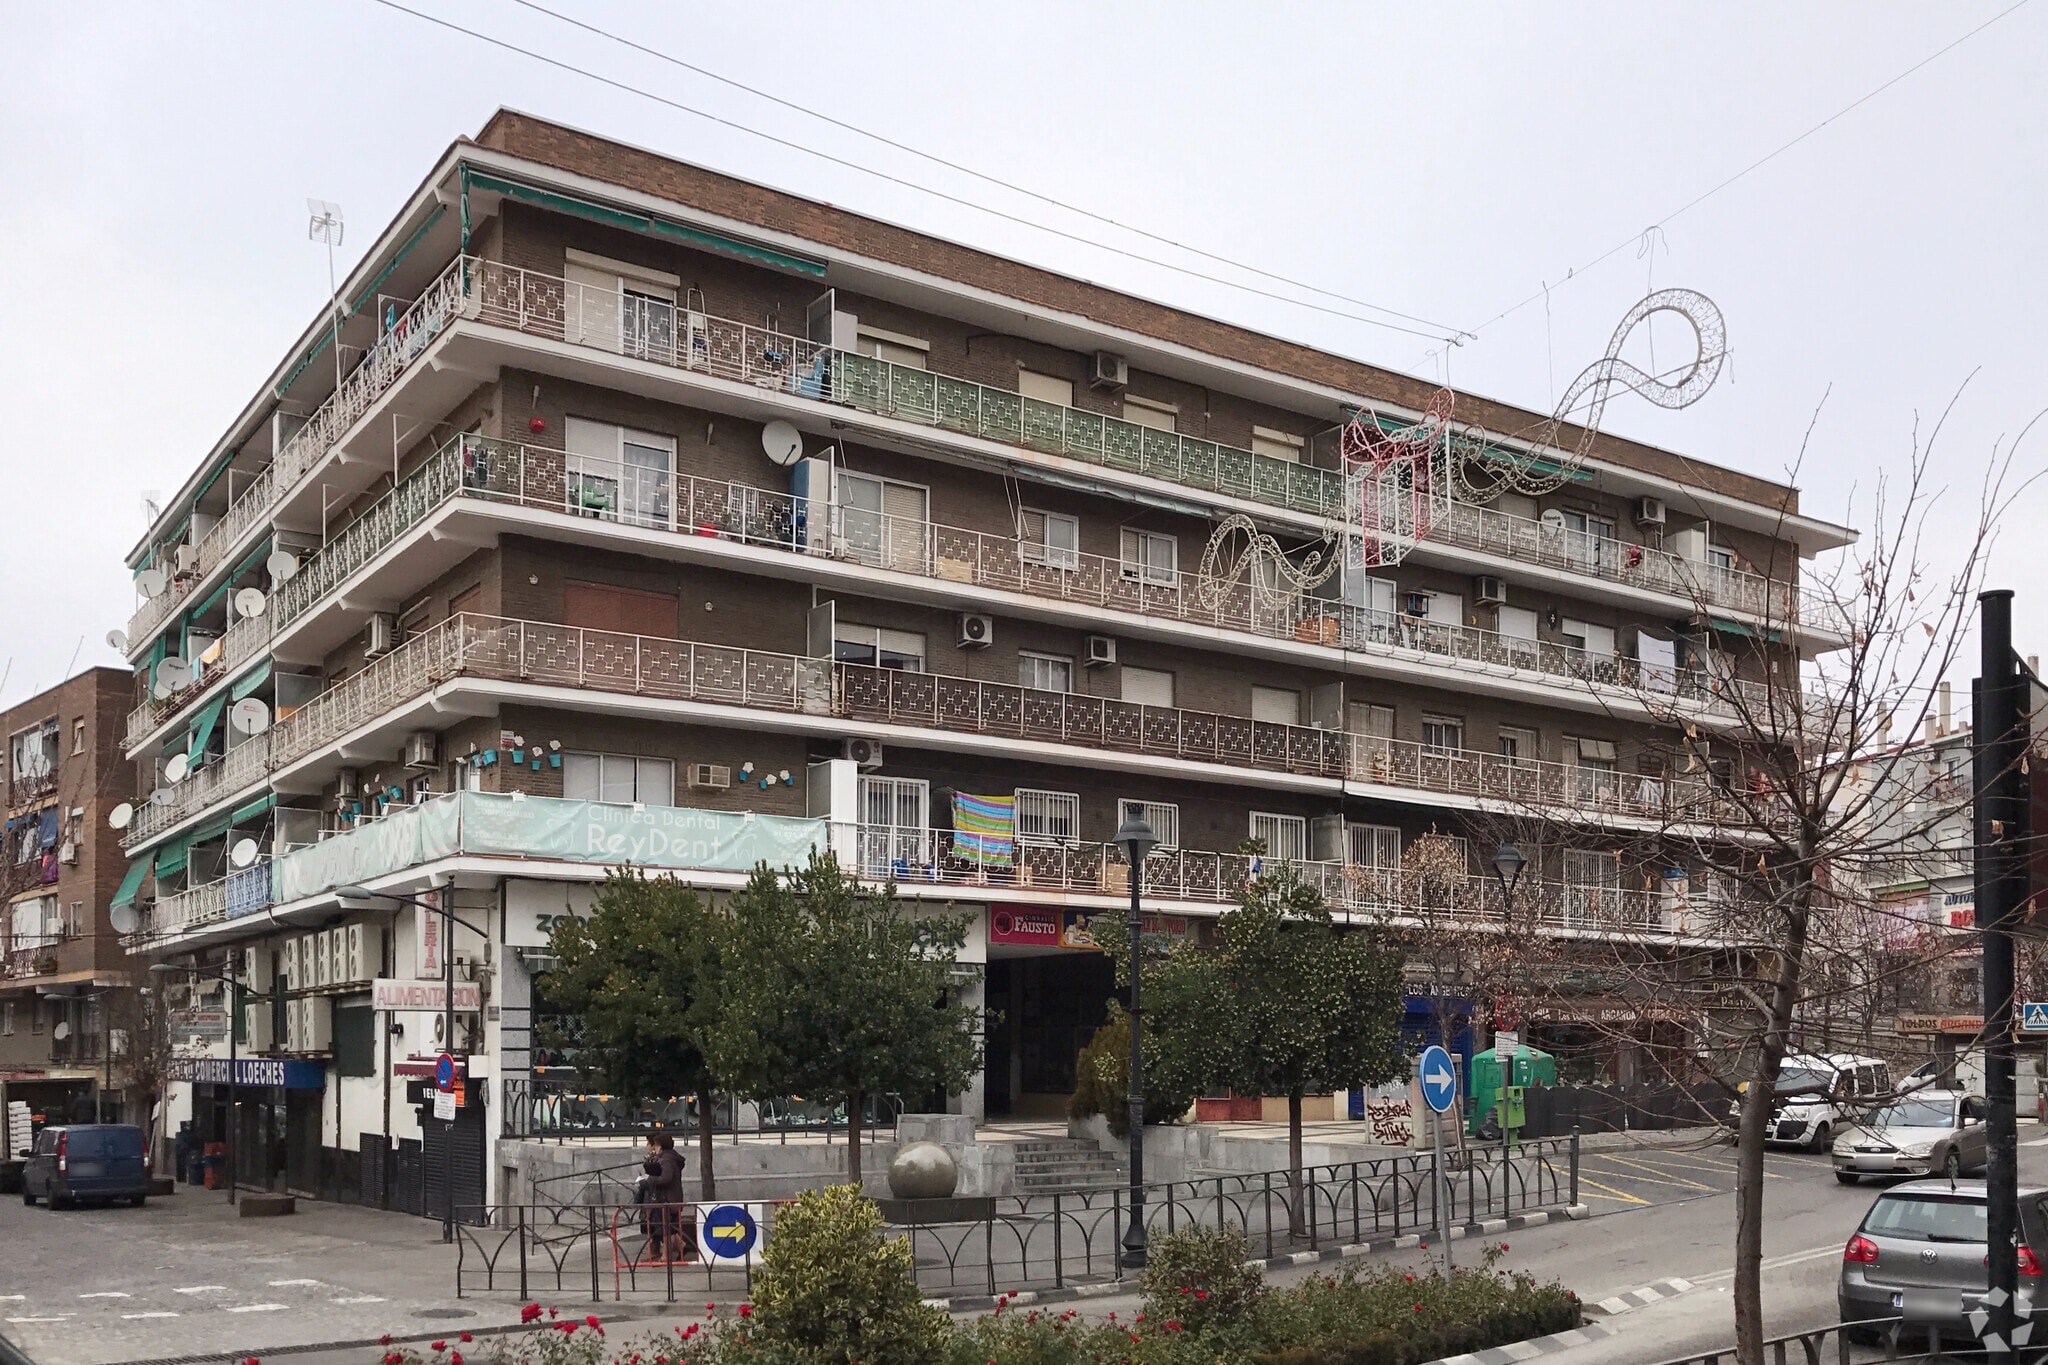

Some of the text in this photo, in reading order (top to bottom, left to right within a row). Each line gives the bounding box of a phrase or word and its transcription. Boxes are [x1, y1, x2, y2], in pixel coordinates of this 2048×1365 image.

[663, 810, 720, 831] Dental
[587, 823, 722, 863] ReyDent
[1014, 916, 1055, 934] FAUSTO
[1901, 1018, 1985, 1030] TOLDOS ARGAND
[195, 1060, 240, 1083] COMERCIL
[242, 1062, 285, 1086] LOECHES
